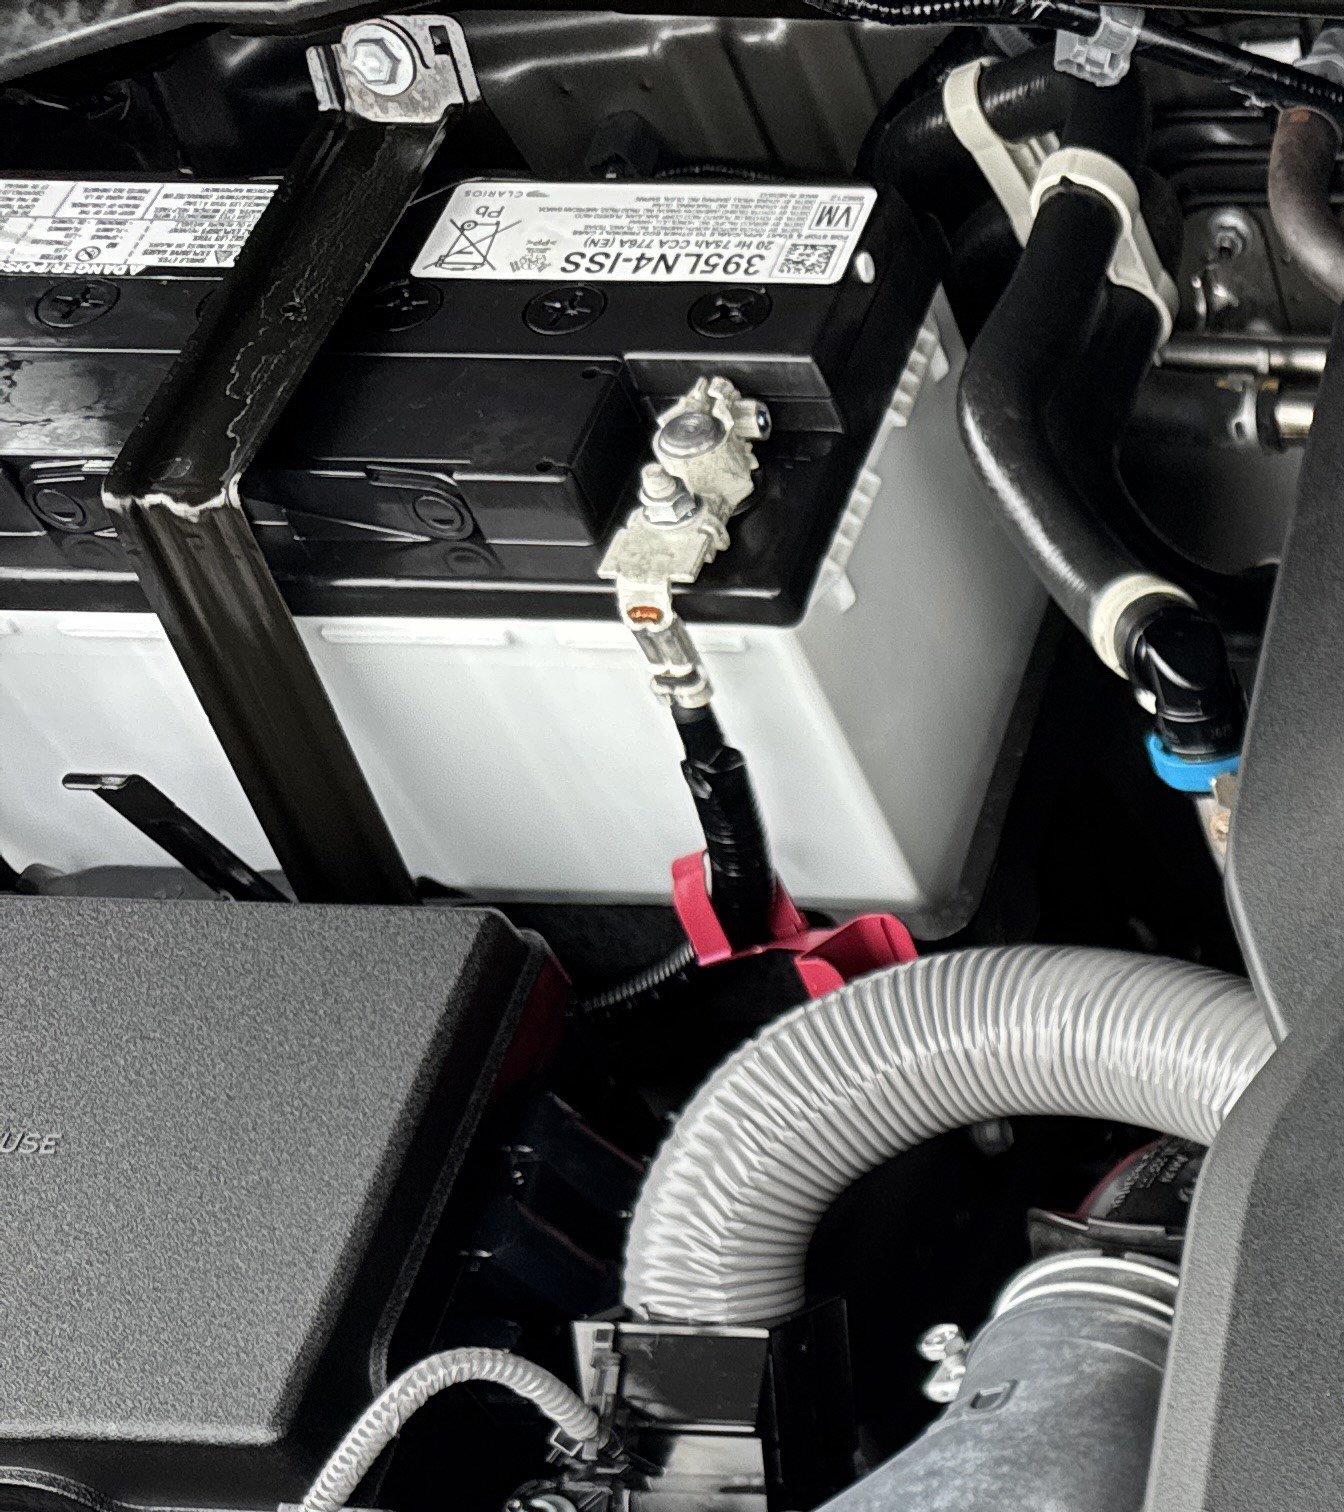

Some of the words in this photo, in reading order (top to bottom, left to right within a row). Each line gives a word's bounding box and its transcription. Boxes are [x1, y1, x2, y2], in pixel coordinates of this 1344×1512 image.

[464, 190, 524, 199] CLARIOS
[475, 205, 505, 219] Pb
[815, 205, 852, 228] VM
[583, 237, 616, 249] (EN)
[618, 239, 654, 249] 776A
[659, 240, 691, 250] CCA
[695, 240, 730, 250] 75Ah
[735, 240, 753, 250] Hr
[757, 240, 774, 250] 20
[560, 251, 767, 277] 395LN4-ISS
